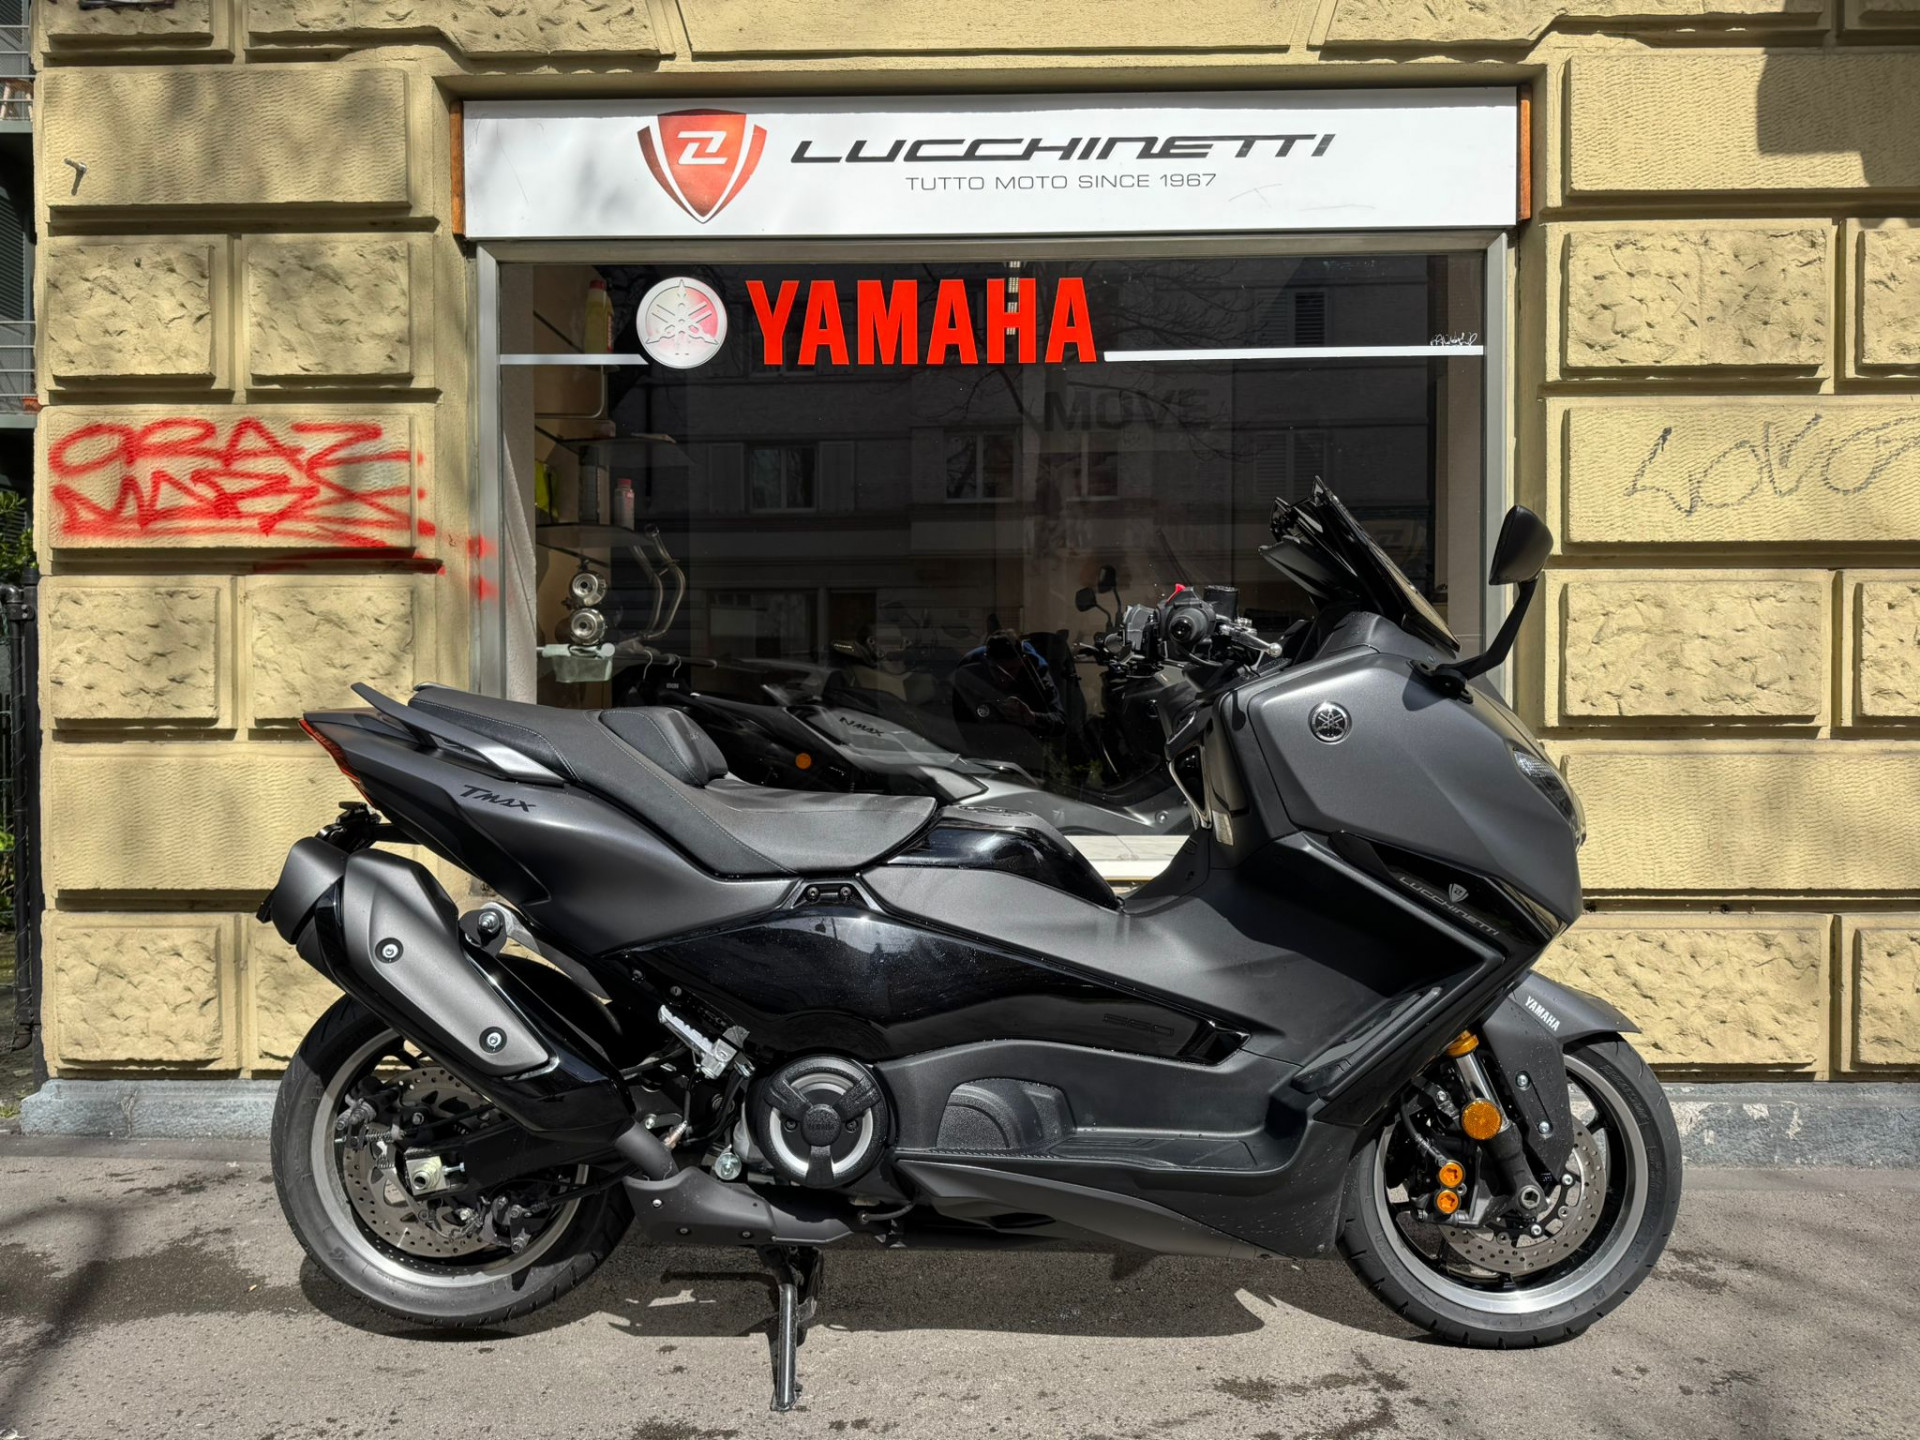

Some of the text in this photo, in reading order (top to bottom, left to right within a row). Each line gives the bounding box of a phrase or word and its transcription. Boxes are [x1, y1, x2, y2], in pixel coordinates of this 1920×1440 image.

[790, 133, 1336, 163] LUCCHINETTI
[905, 173, 1217, 191] TUTTO MOTO SINCE 1967
[745, 276, 1098, 366] YAMAHA
[1043, 388, 1211, 432] MOVE
[459, 784, 537, 813] TMAX
[1399, 876, 1500, 936] LUCCHINETTI
[1524, 995, 1561, 1031] YAMAHA
